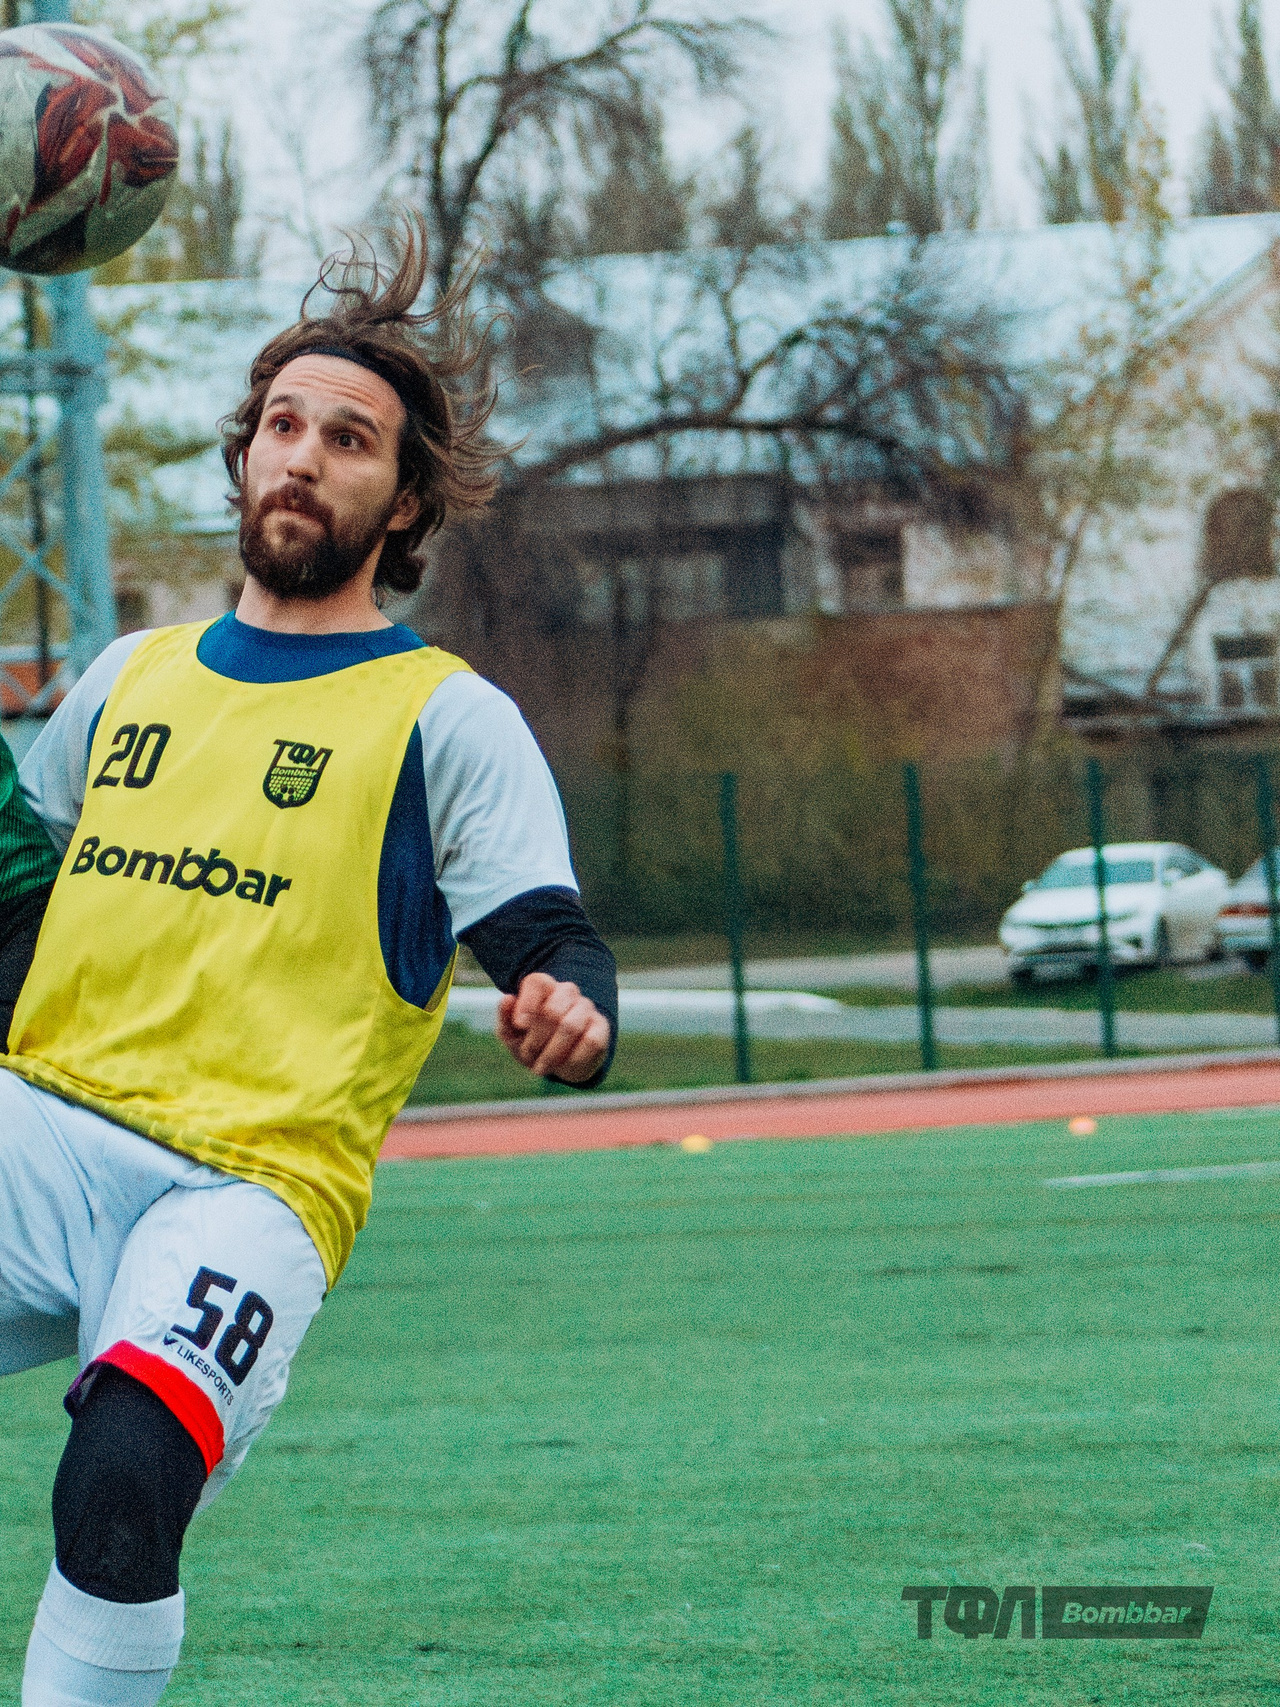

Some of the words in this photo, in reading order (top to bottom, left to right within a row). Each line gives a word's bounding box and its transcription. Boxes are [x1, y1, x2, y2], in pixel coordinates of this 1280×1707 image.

[92, 723, 172, 789] 20
[70, 835, 293, 907] Bombbar
[170, 1265, 274, 1387] 58
[176, 1345, 235, 1406] LIKESPORTS
